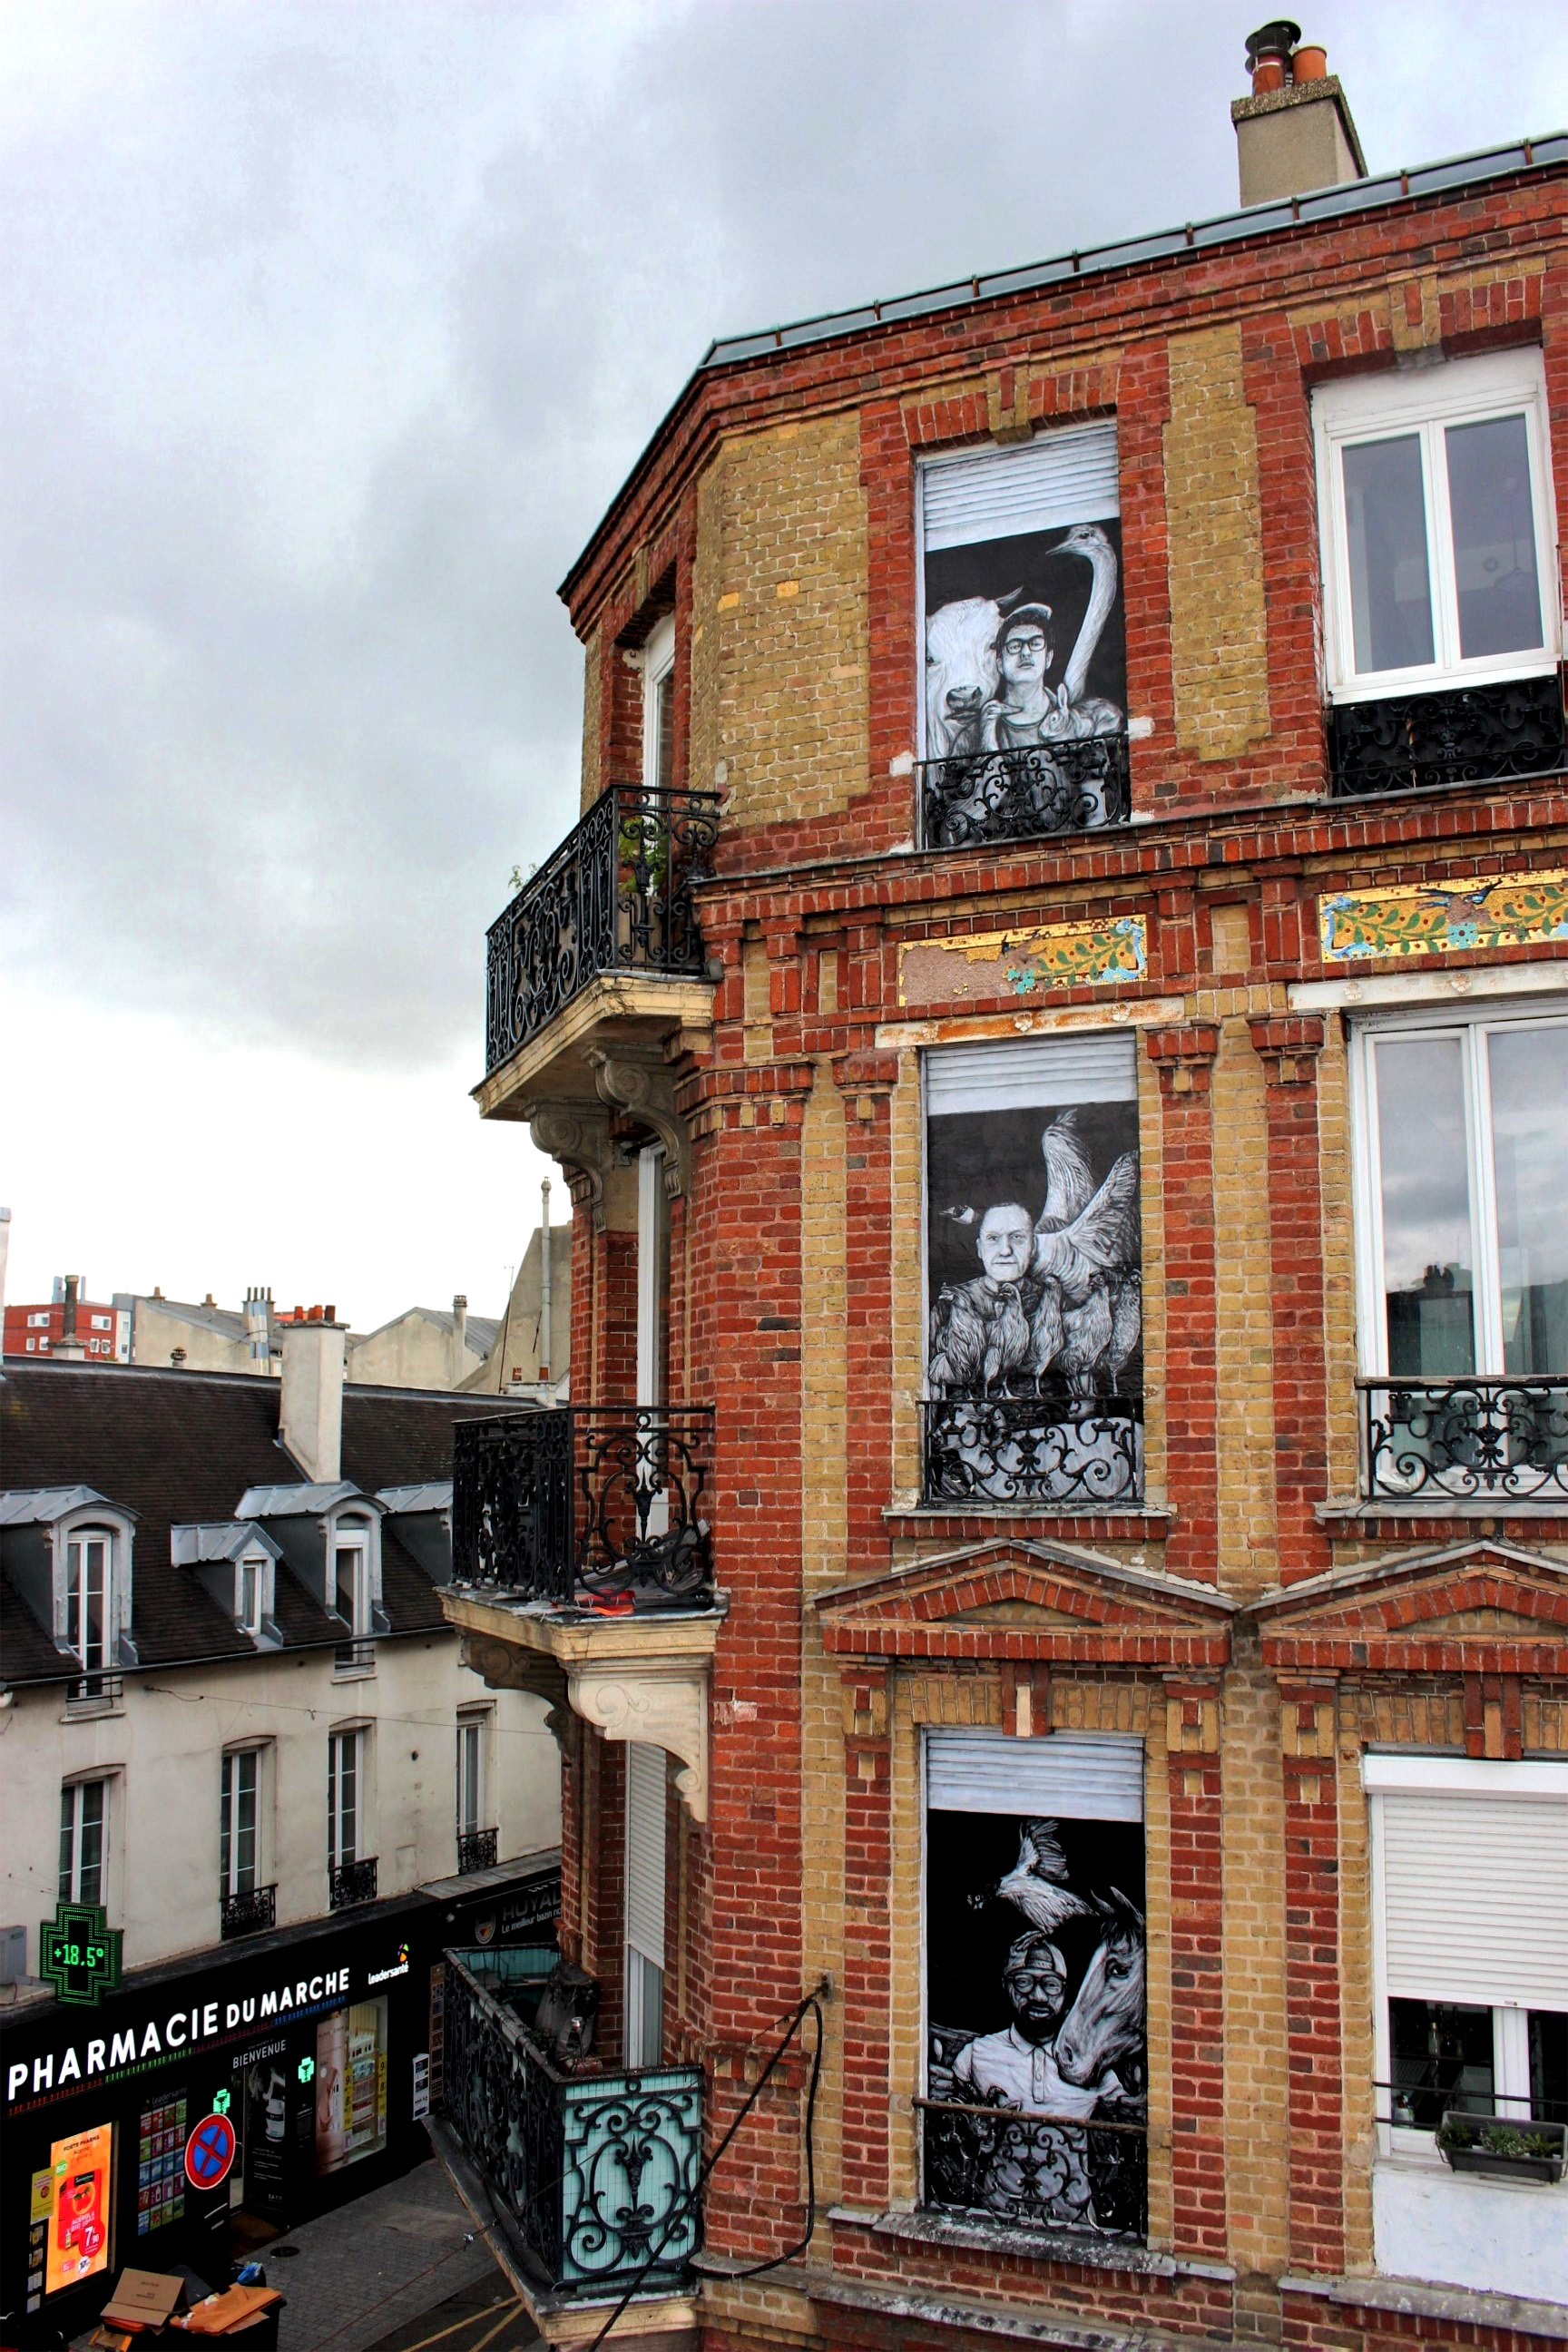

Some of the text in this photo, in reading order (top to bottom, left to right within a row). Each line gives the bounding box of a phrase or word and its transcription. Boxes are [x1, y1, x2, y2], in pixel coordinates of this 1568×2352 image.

[7, 2002, 219, 2102] PHARMACIE
[227, 1997, 255, 2028] DU
[232, 2039, 286, 2069] BIENVENUE
